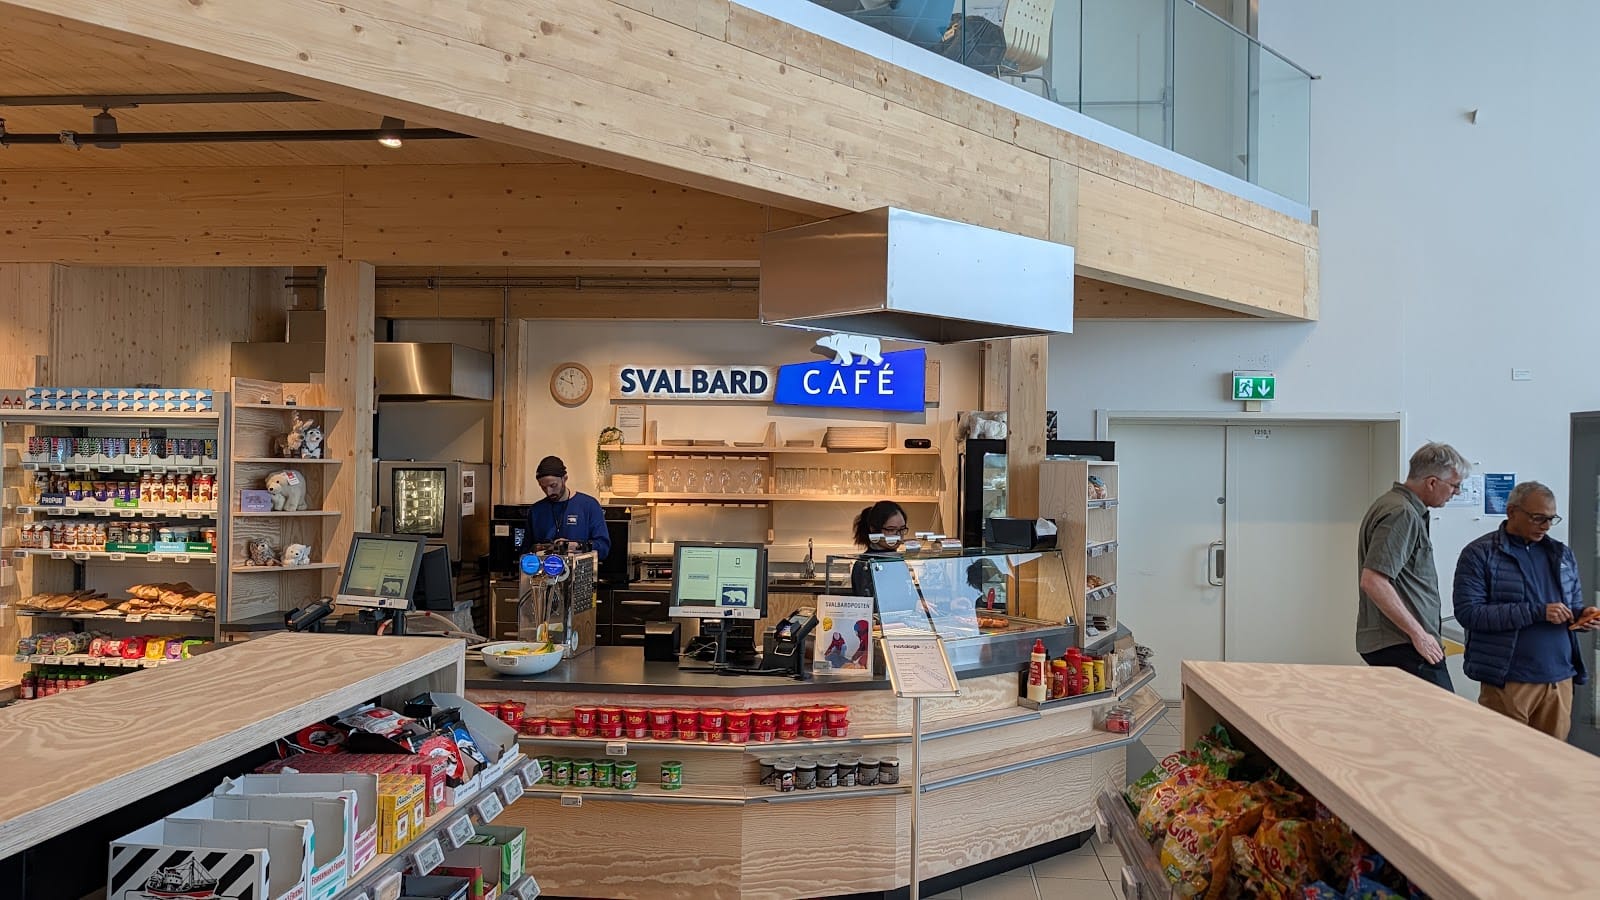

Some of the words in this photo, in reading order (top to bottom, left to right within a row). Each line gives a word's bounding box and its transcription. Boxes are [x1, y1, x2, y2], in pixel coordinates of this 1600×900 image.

[620, 368, 768, 394] SVALBARD
[803, 363, 895, 395] CAFÉ
[825, 601, 870, 609] SVALBARDPOSTEN
